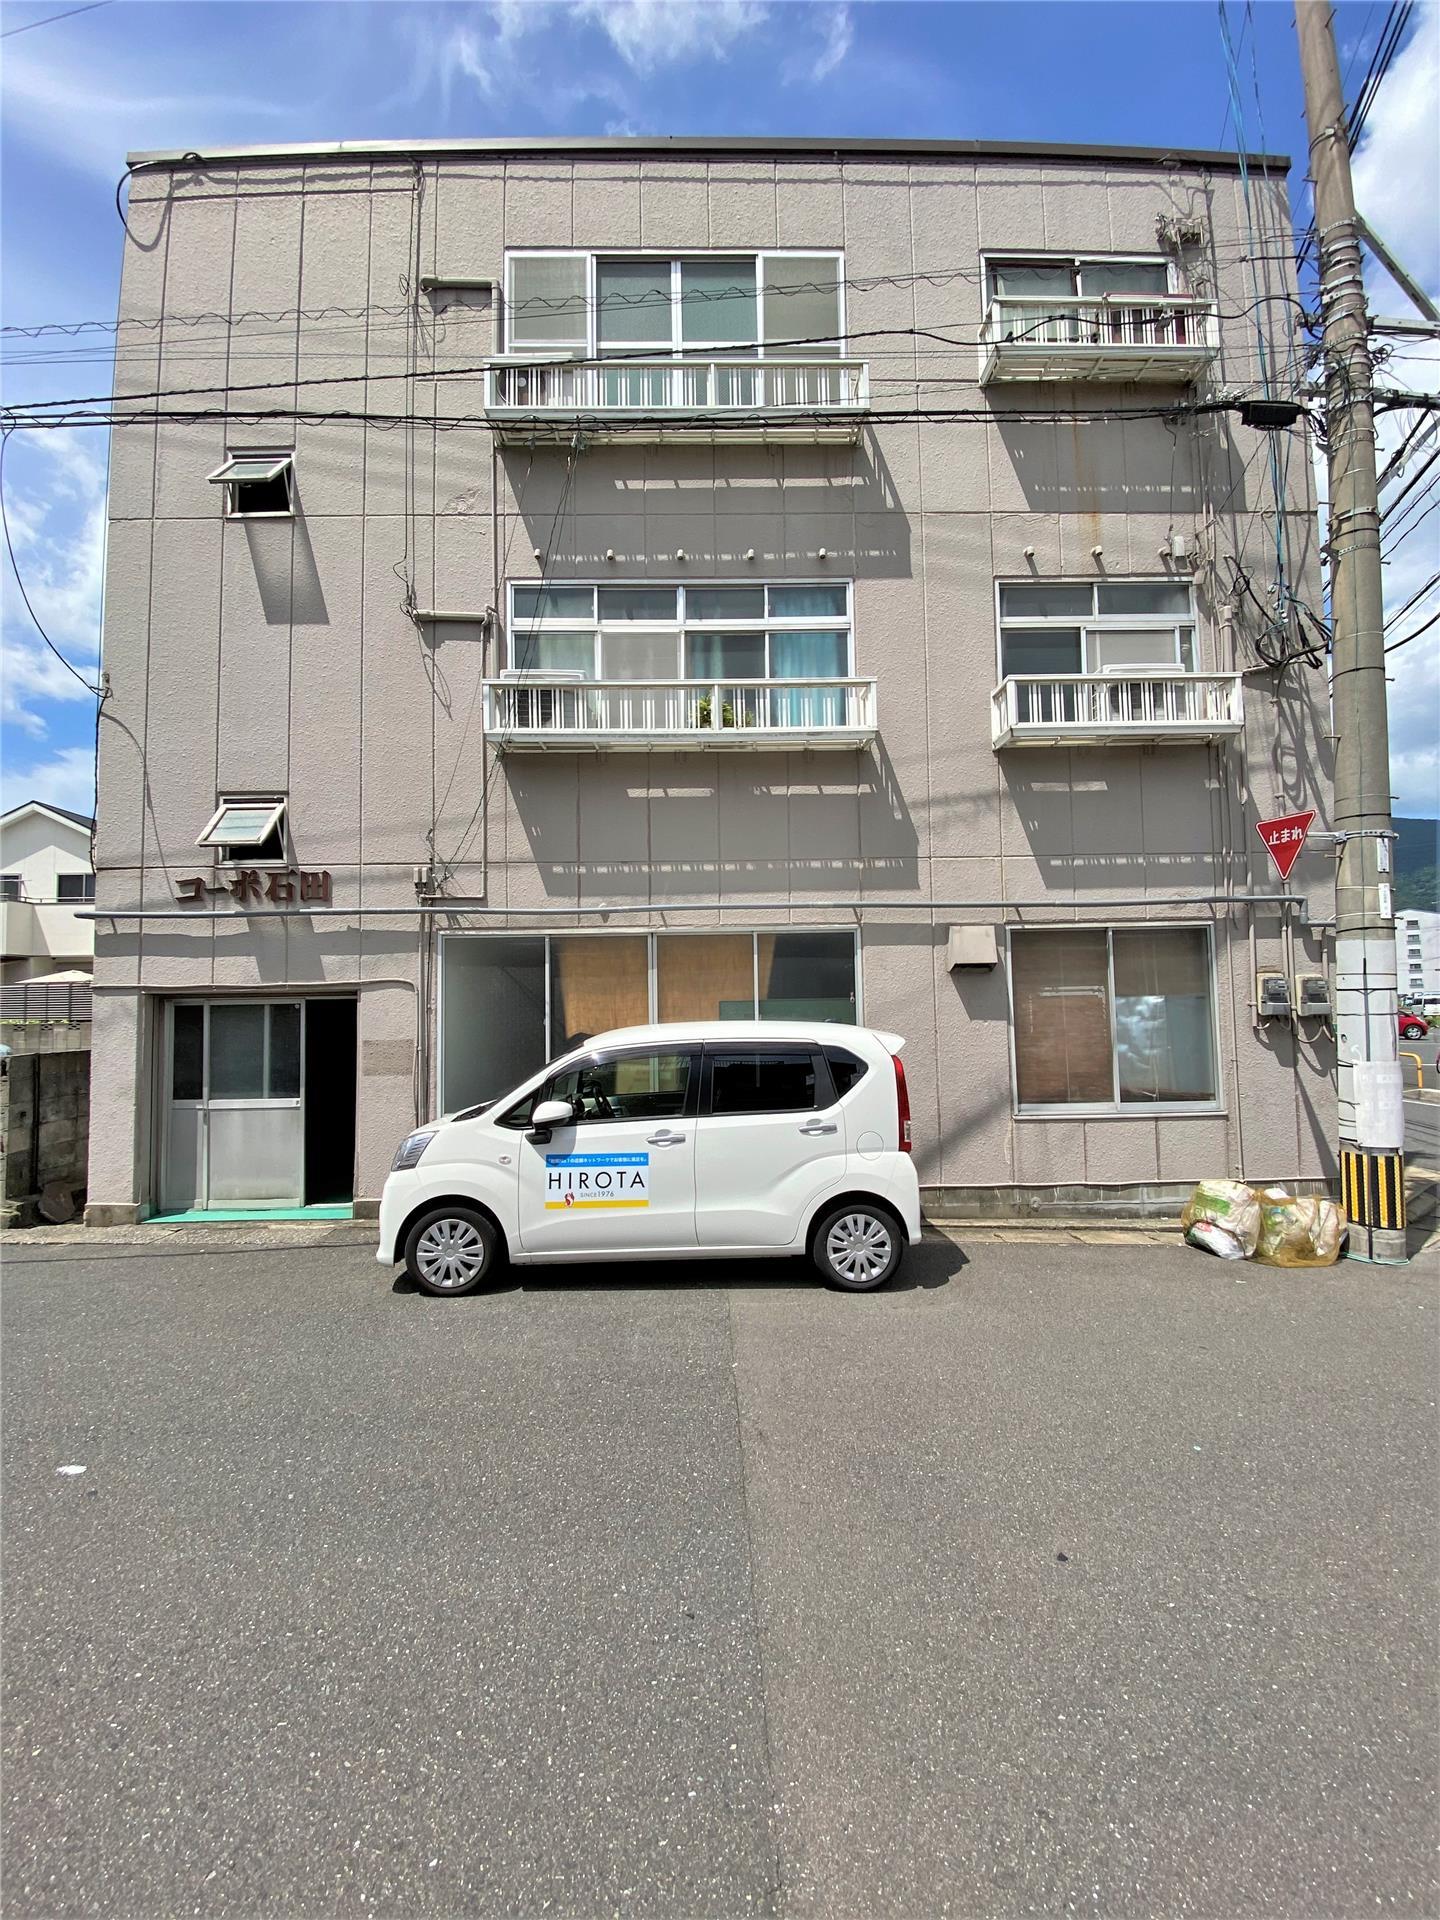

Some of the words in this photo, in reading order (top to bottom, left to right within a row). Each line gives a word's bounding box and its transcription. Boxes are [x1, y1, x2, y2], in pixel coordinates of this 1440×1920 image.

[1268, 826, 1303, 845] 止まれ
[175, 870, 331, 902] コーポ石田
[549, 1171, 645, 1189] HIROTA
